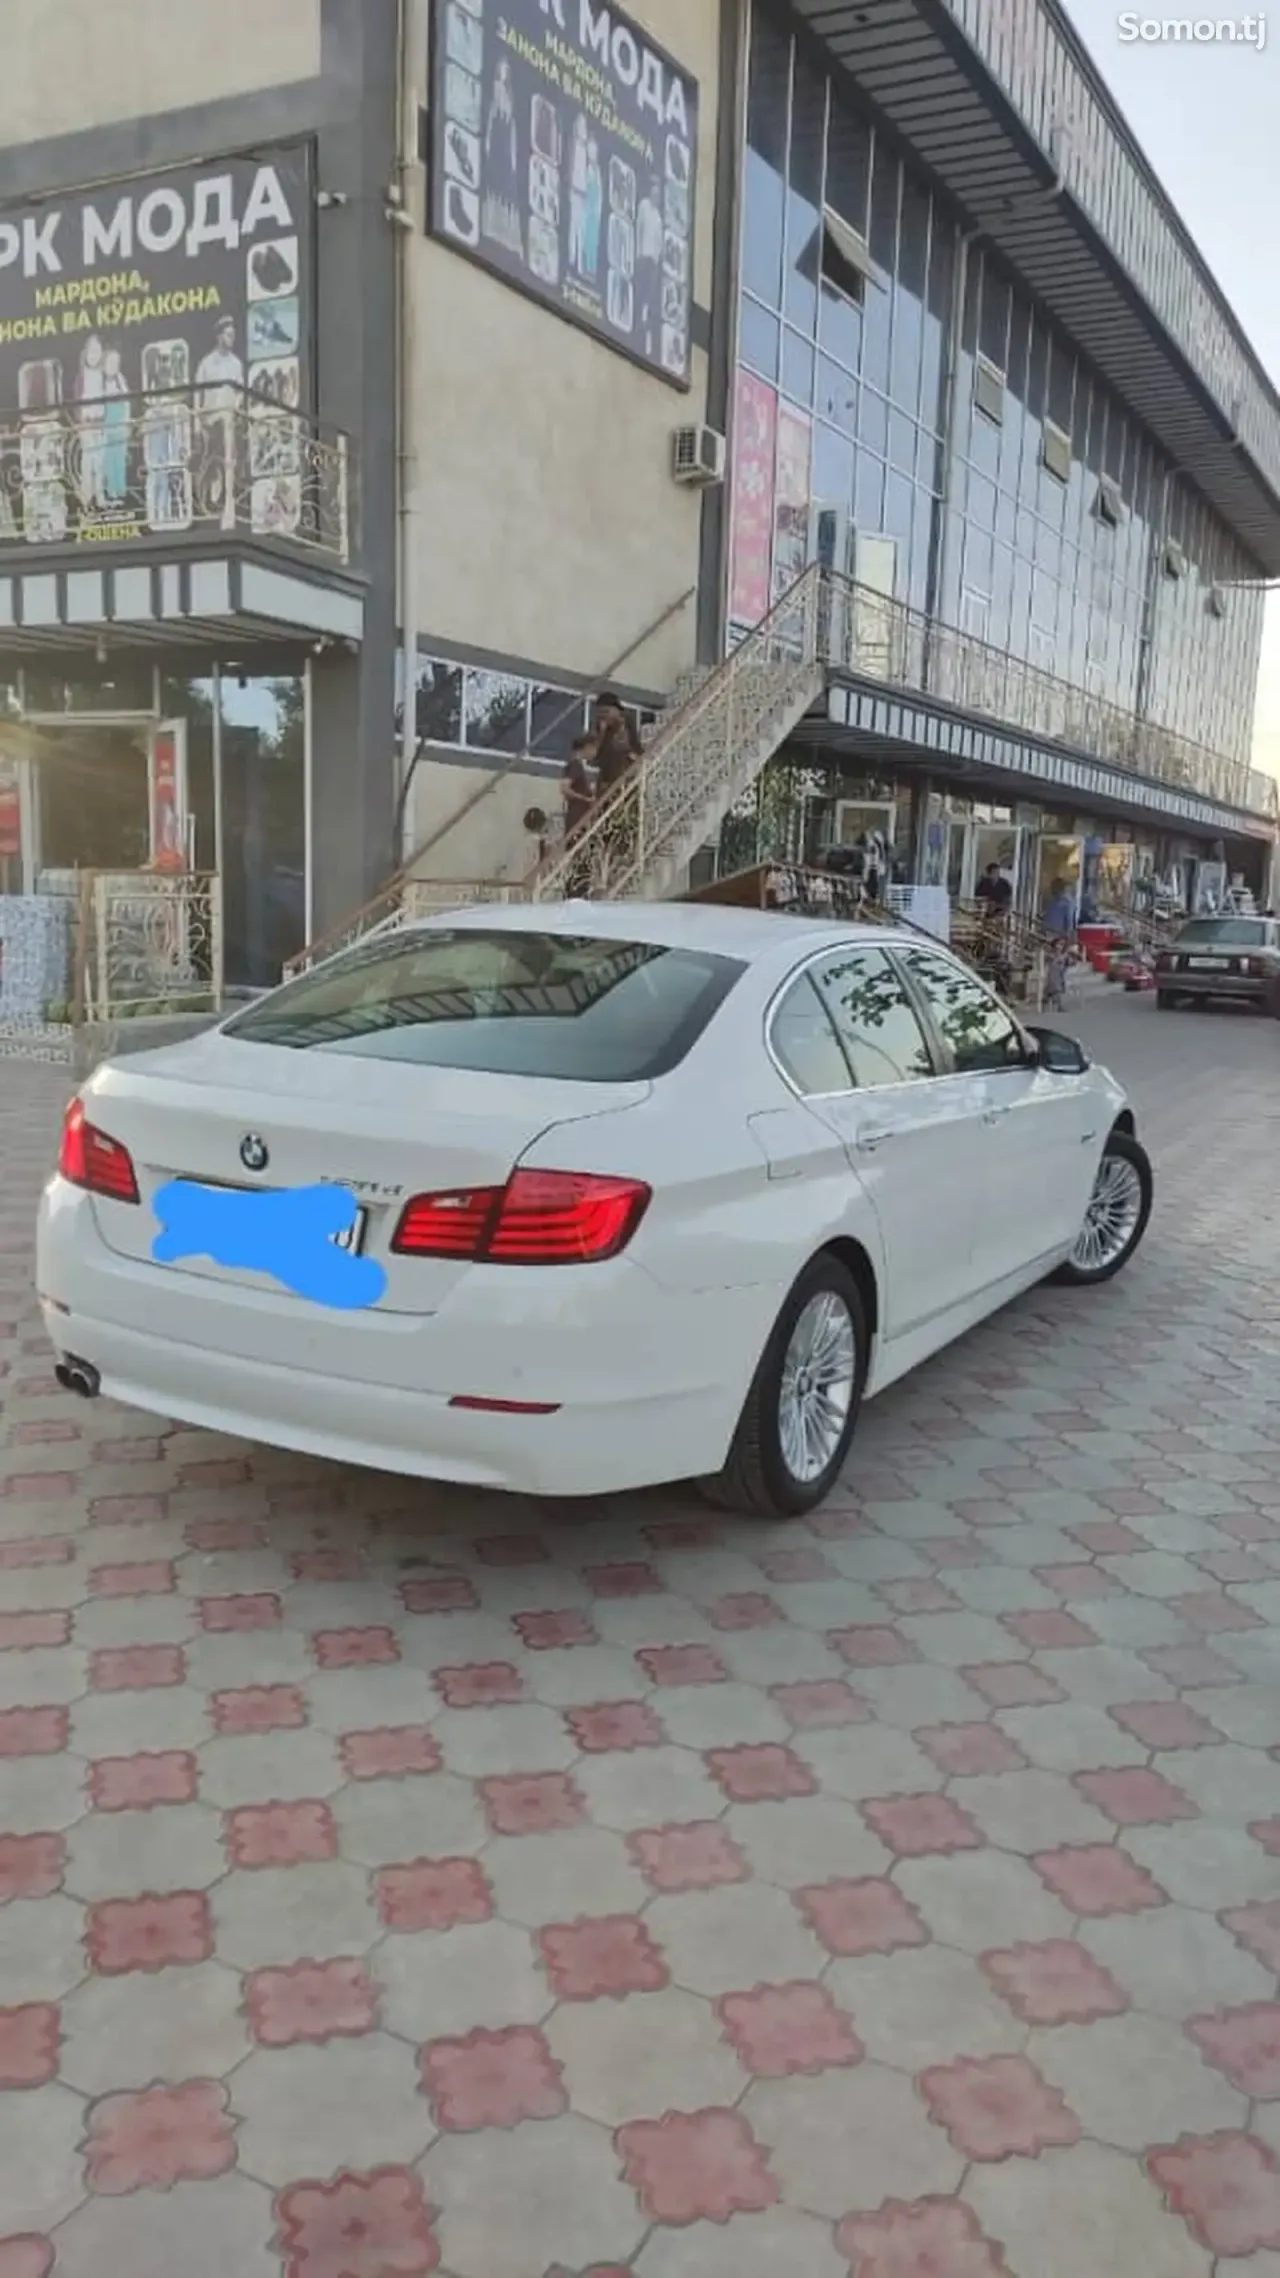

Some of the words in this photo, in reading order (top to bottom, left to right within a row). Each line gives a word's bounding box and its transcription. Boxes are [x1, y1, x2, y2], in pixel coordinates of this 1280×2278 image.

[579, 0, 688, 137] МОДА
[83, 165, 293, 264] МОДА
[35, 269, 149, 308] МАРДОНА,
[62, 309, 92, 334] ВА
